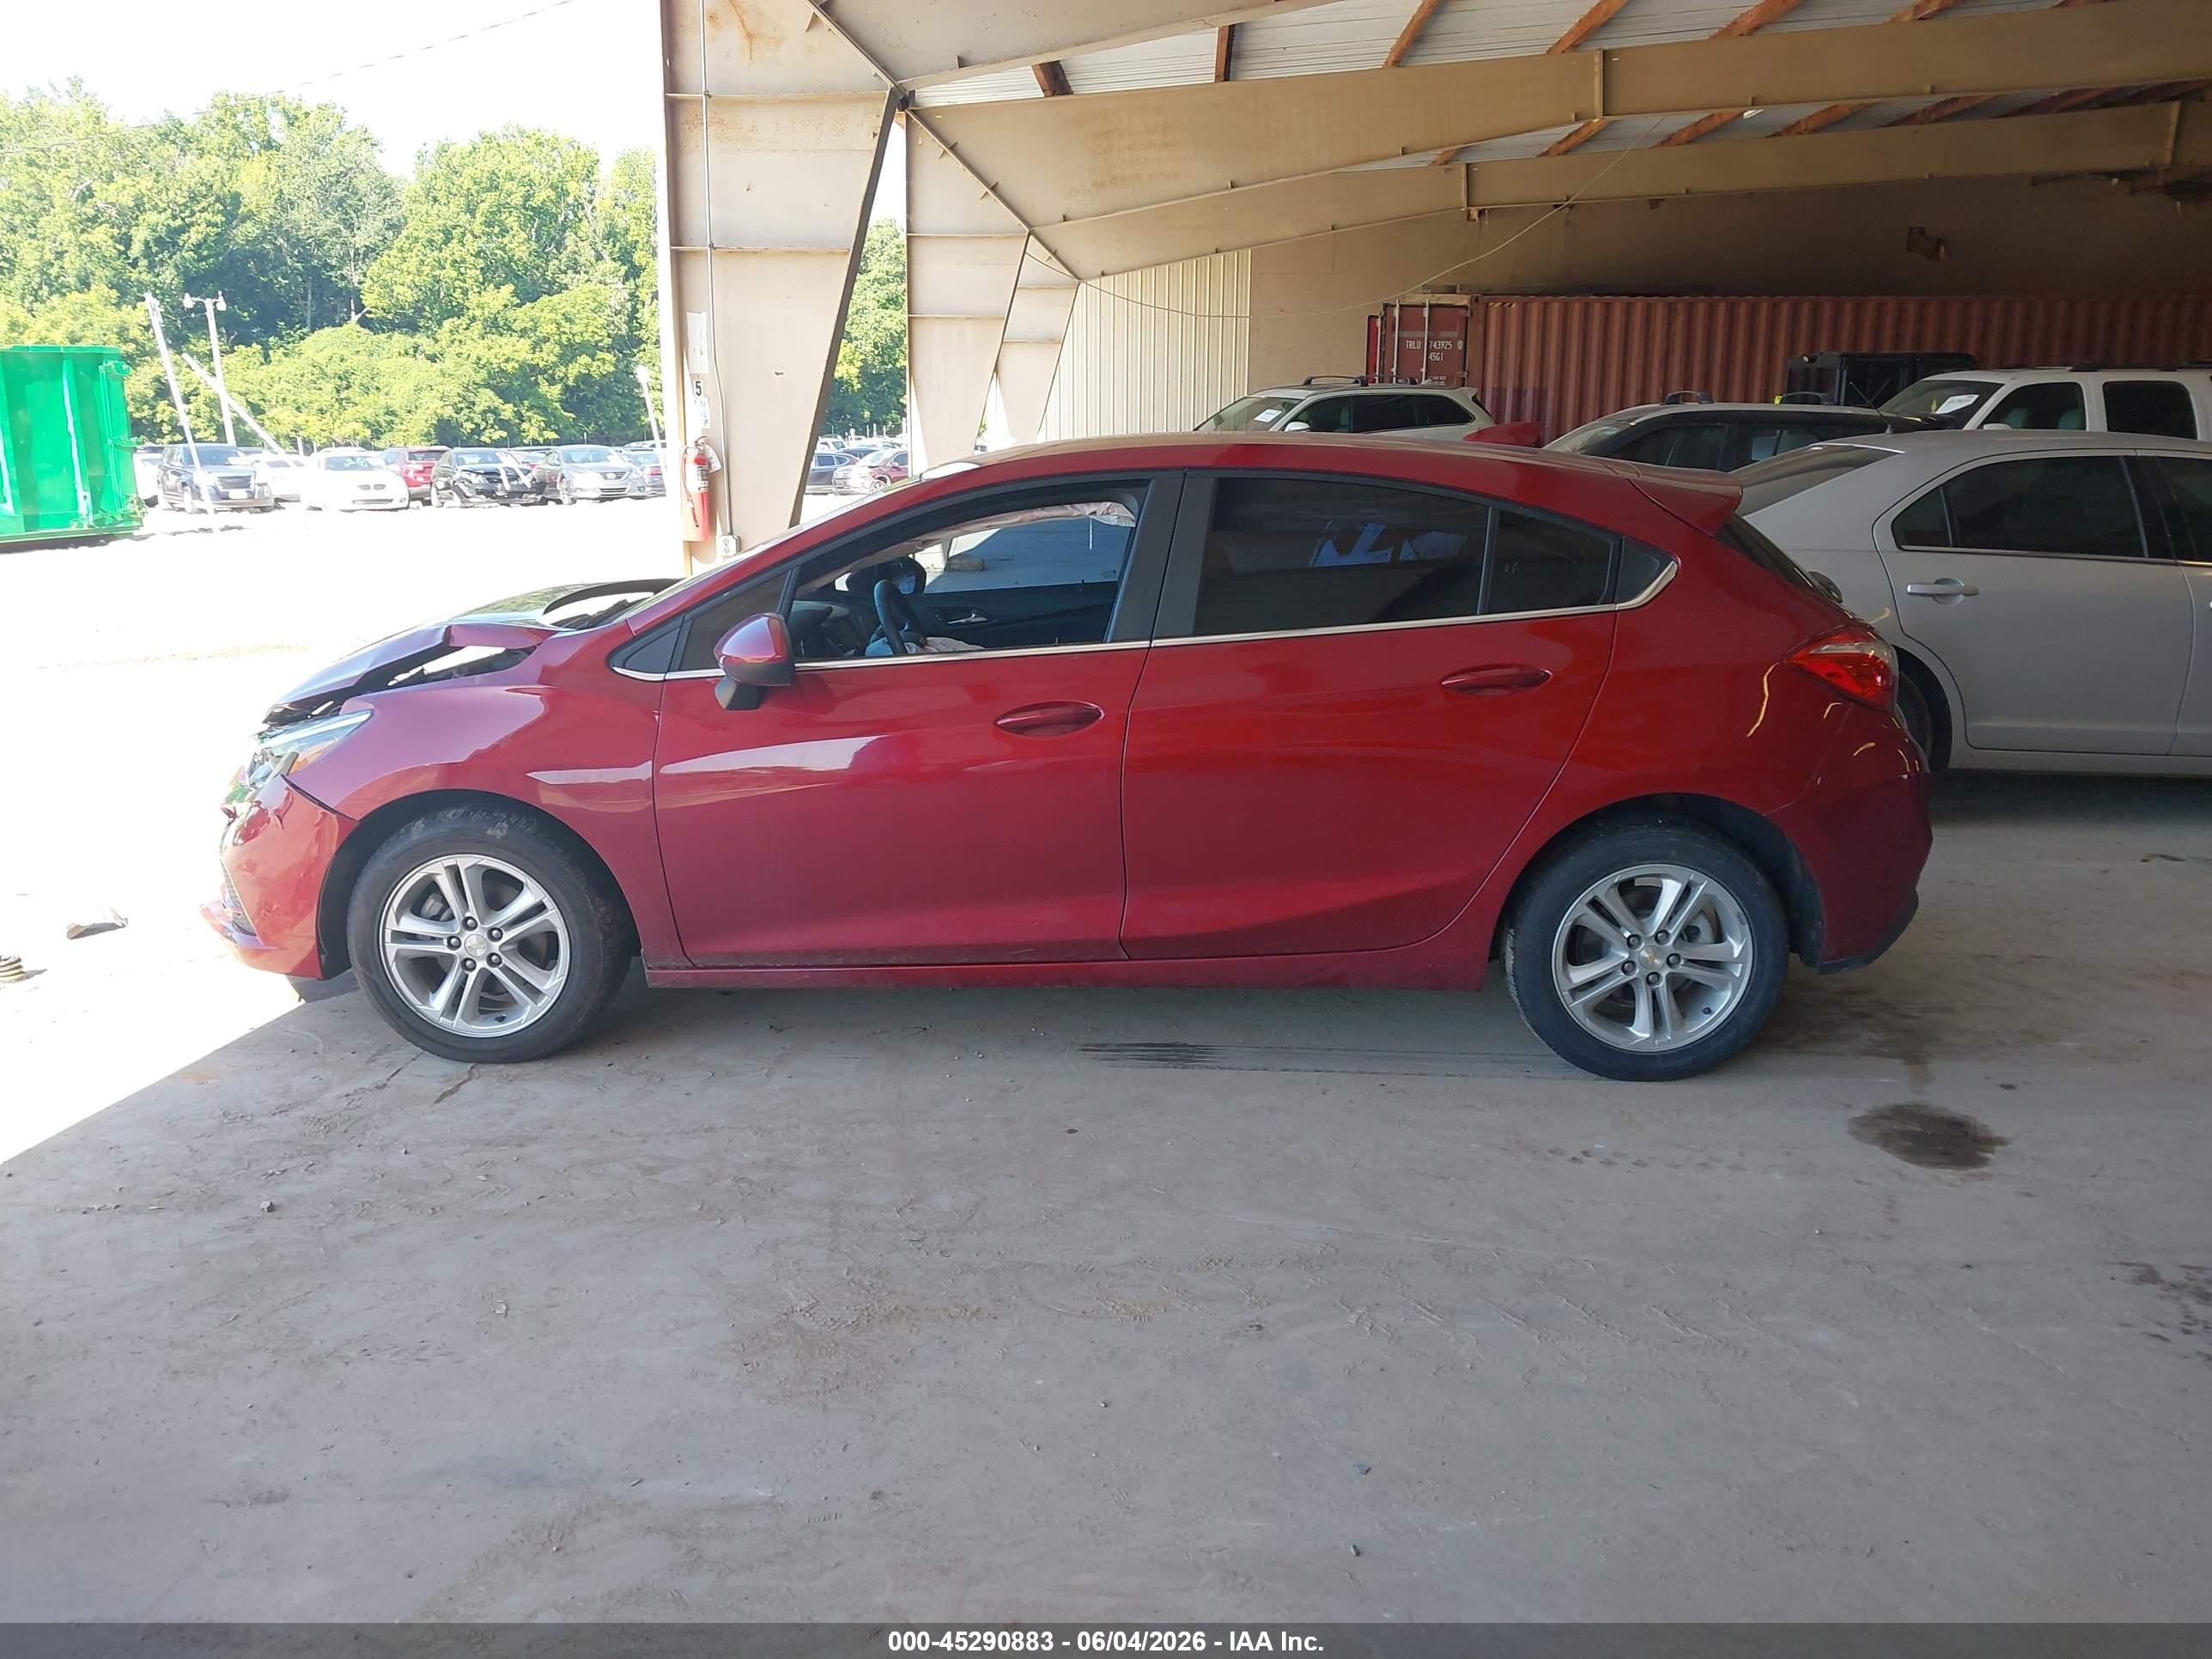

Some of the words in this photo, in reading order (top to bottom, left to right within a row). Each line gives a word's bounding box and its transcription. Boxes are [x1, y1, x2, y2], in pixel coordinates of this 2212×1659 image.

[1406, 340, 1421, 349] TRLU
[1428, 352, 1443, 362] 45G1
[696, 380, 702, 396] 5
